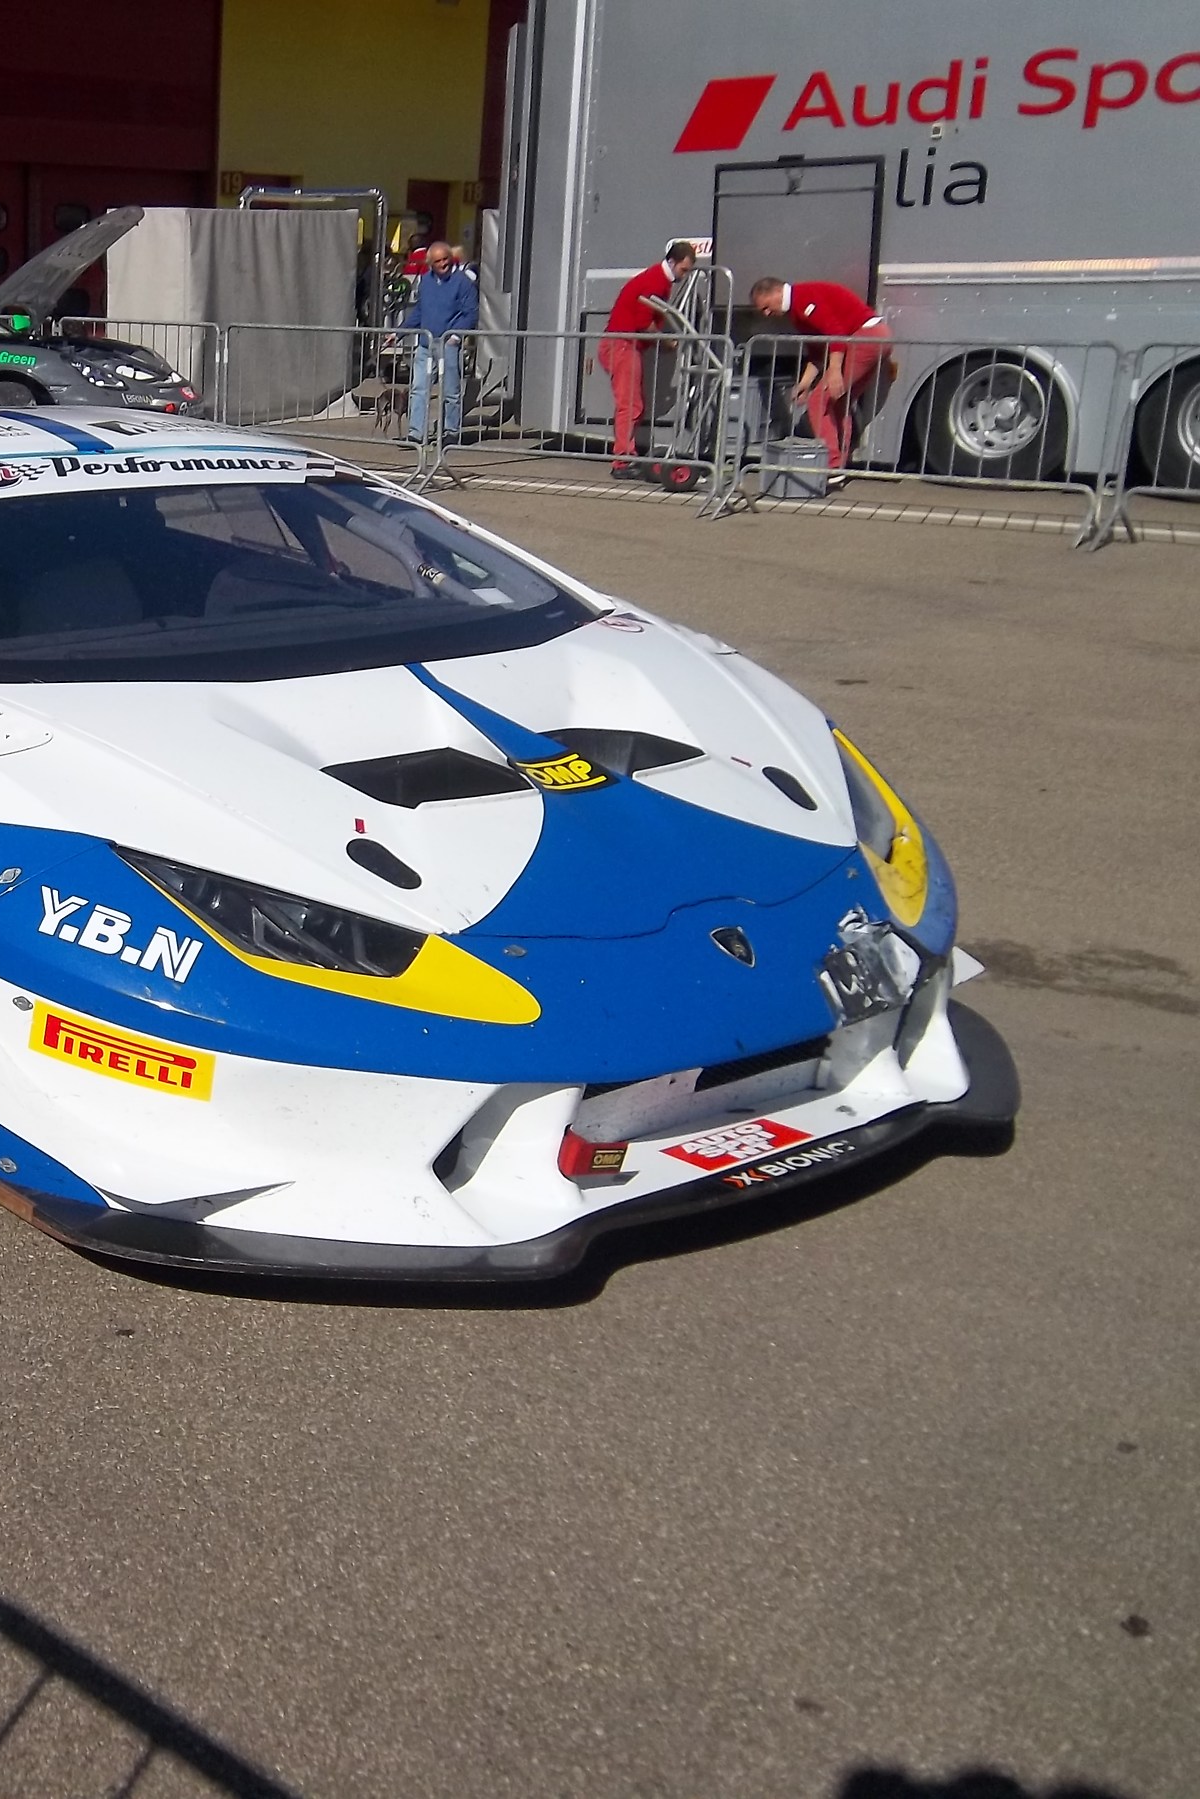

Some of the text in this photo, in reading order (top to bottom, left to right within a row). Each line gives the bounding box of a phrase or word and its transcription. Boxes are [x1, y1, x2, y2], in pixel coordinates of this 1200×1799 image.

[780, 56, 990, 132] Audi
[41, 455, 302, 478] Performance
[525, 759, 592, 785] OMP
[37, 884, 204, 984] Y.B.N
[43, 1012, 197, 1089] PIRELLI
[681, 1122, 764, 1154] AUTO
[593, 1154, 622, 1166] OMP
